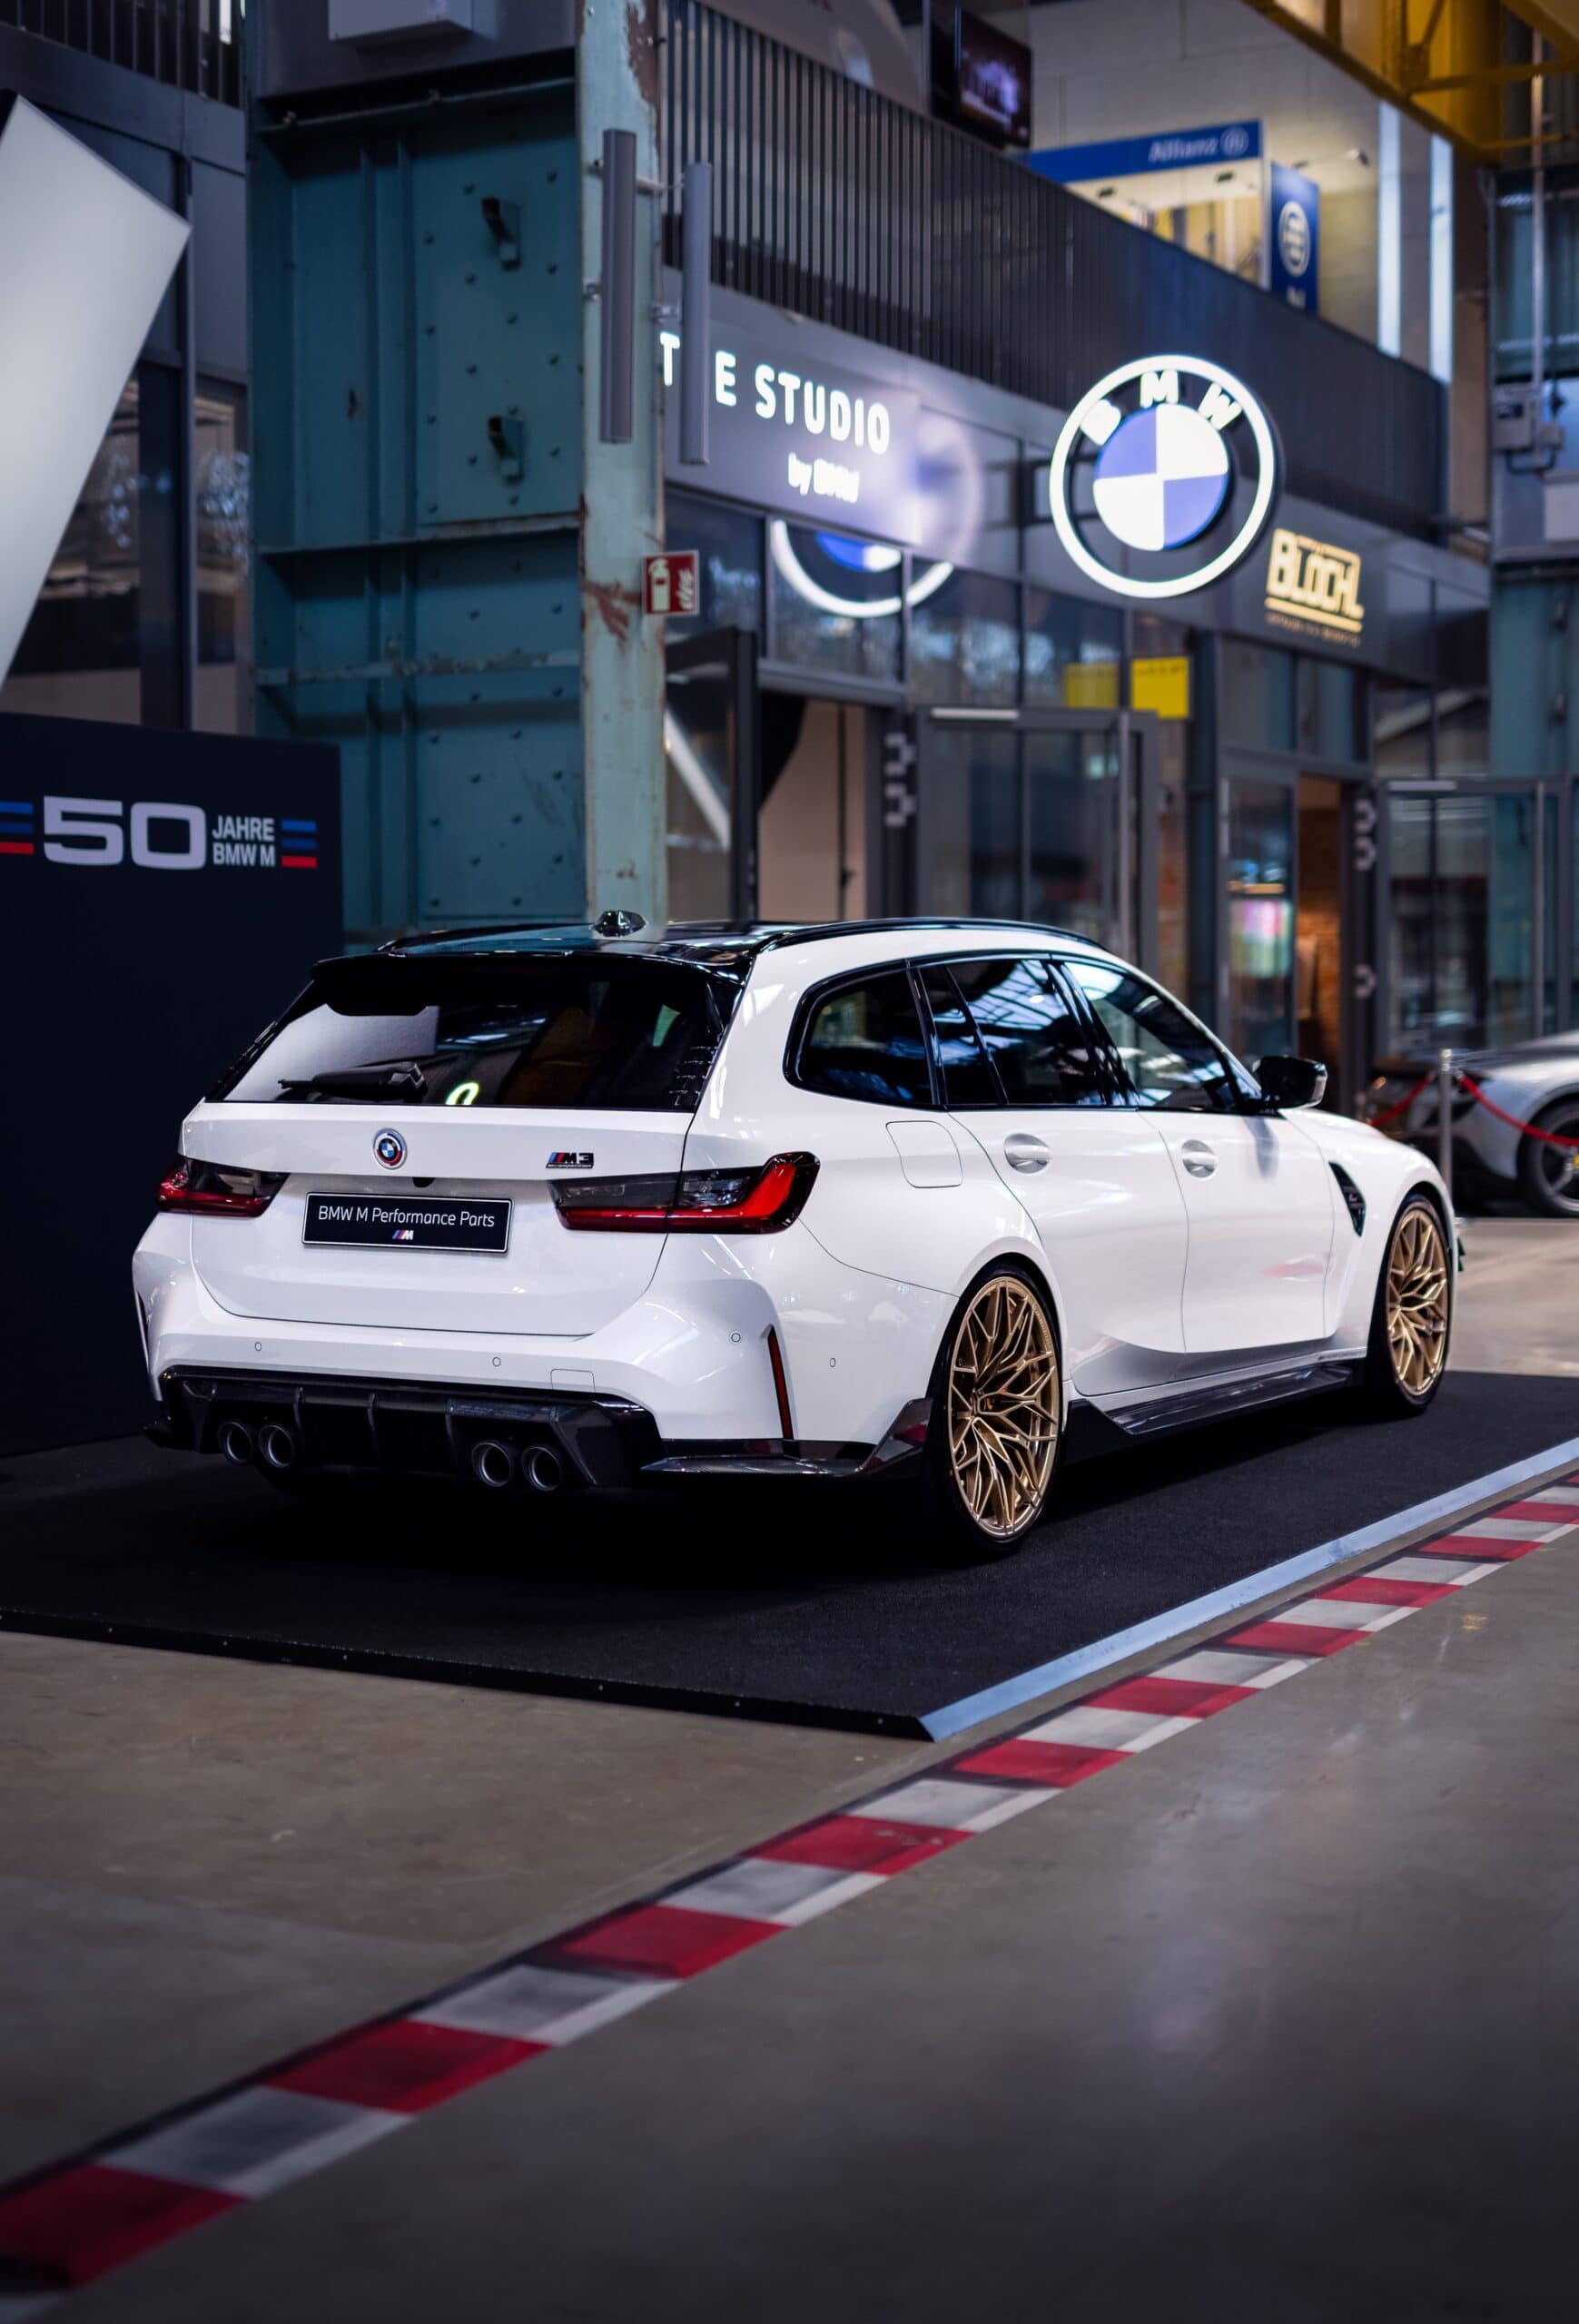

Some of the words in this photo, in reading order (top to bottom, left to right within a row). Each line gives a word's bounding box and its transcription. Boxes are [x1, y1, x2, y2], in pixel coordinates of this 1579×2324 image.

[1148, 137, 1219, 163] Allianz
[659, 332, 737, 407] TE
[755, 364, 891, 455] STUDIO
[1081, 370, 1243, 446] BMW
[788, 452, 813, 496] by
[44, 796, 207, 870] 50
[212, 815, 275, 841] JAHRE
[212, 842, 258, 866] BMW
[260, 843, 275, 867] M
[559, 1152, 595, 1164] M3
[318, 1206, 353, 1221] BMW
[356, 1206, 368, 1221] M
[371, 1207, 456, 1226] Performance
[459, 1212, 495, 1227] Parts
